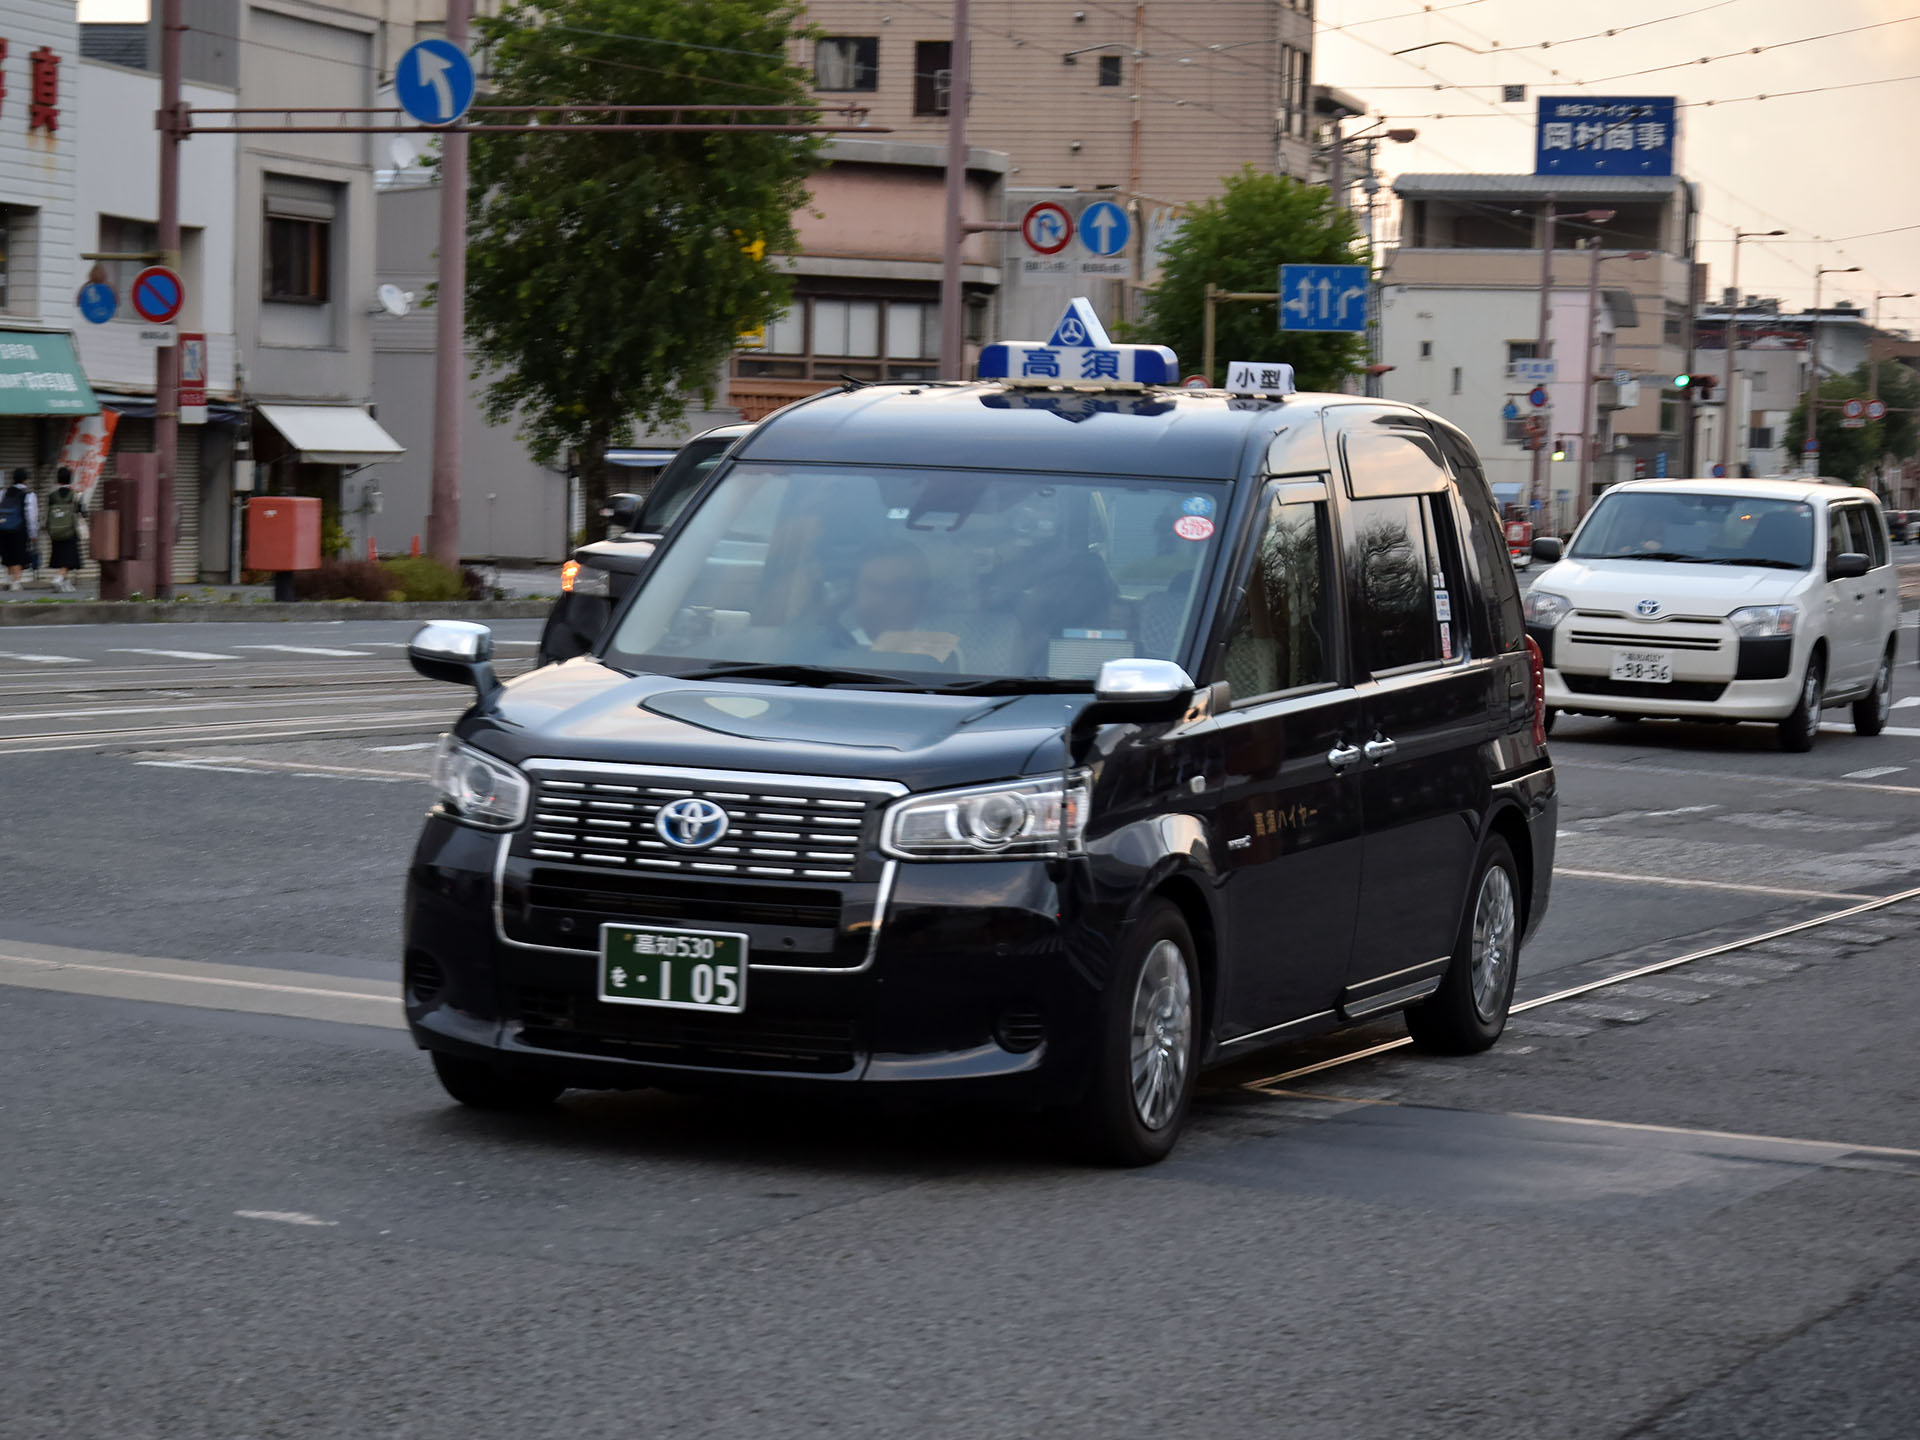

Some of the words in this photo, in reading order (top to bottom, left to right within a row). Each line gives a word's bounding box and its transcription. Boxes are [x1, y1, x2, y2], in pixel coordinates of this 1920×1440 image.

[1543, 122, 1668, 150] 岡村商事
[1022, 347, 1121, 380] 高須
[1235, 367, 1281, 389] 小型
[633, 934, 715, 959] 高知530
